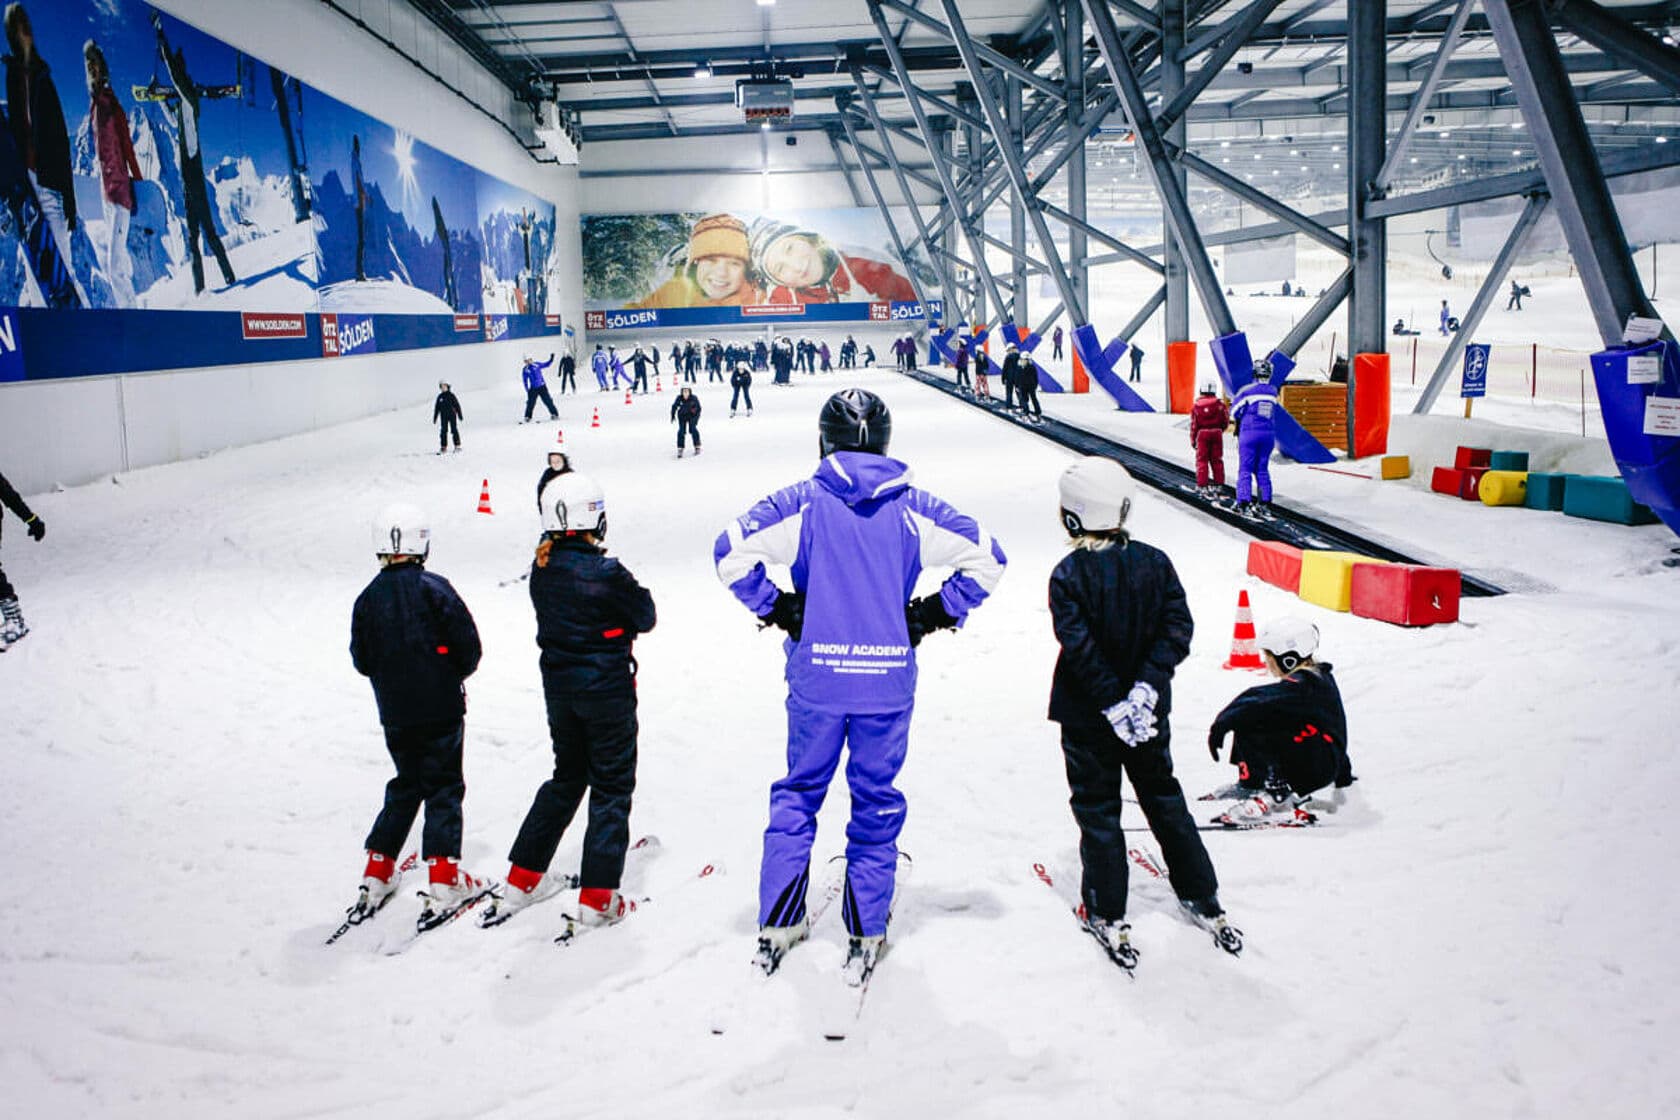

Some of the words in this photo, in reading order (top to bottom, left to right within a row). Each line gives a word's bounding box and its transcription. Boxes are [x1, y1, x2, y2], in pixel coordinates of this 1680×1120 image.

[607, 311, 657, 328] SÖLDEN
[892, 302, 940, 320] SÖLDN
[340, 318, 374, 354] SÖLDEN
[324, 339, 338, 352] TAL
[812, 643, 849, 655] SNOW
[852, 644, 909, 656] ACADEMY
